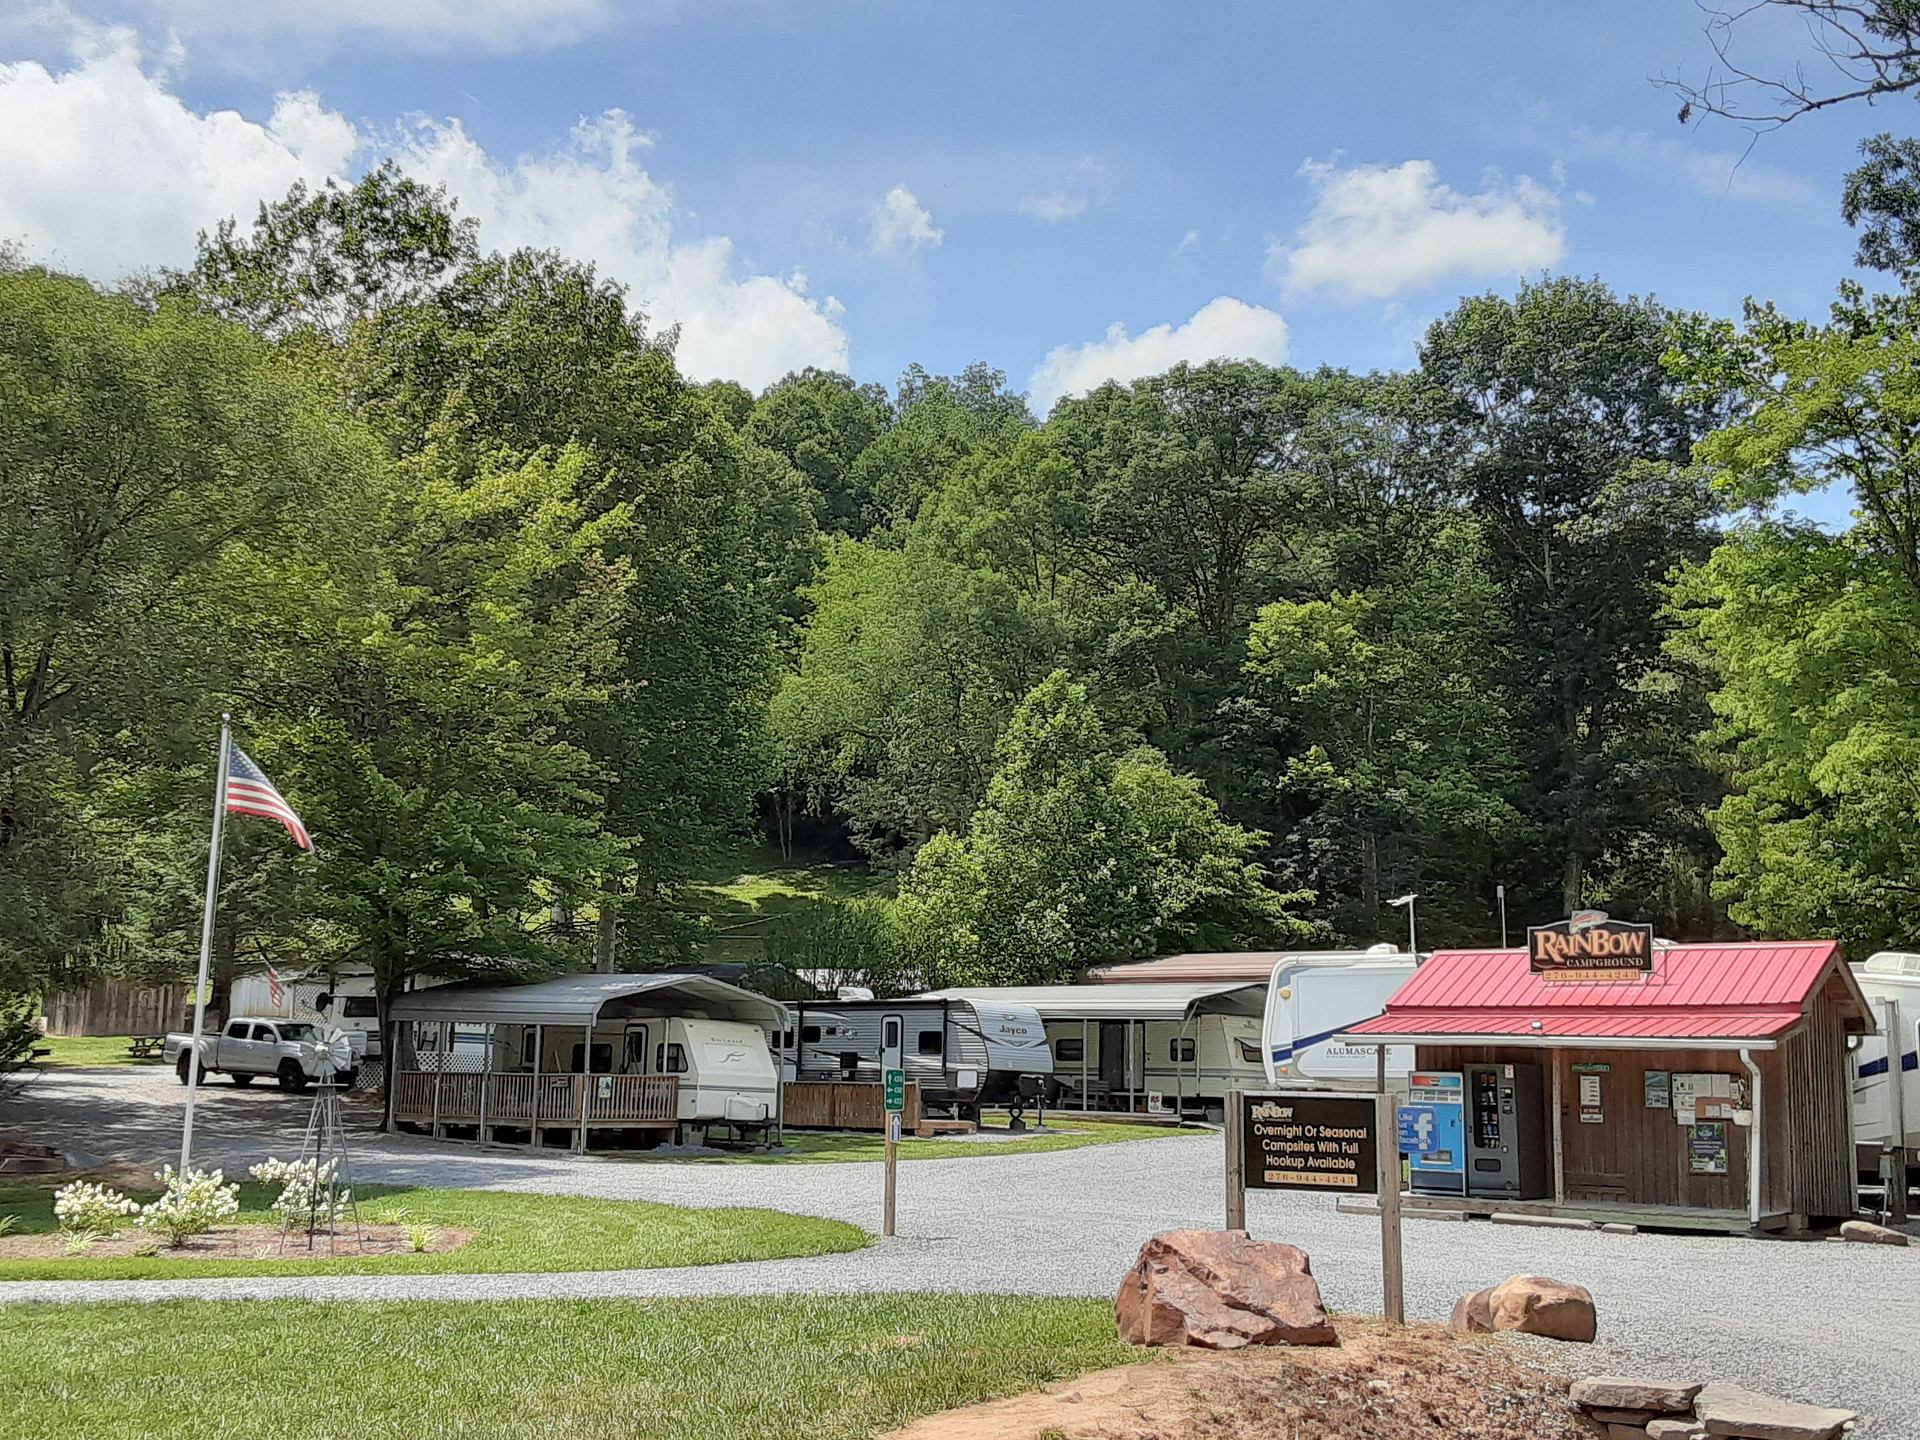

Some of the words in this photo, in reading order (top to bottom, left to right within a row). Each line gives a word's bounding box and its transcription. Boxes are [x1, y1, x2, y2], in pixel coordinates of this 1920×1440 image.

[1566, 957, 1644, 968] CAMPGROUND
[999, 1024, 1028, 1036] Jayco
[1326, 1047, 1393, 1056] ALUMASCAE
[1253, 1123, 1303, 1139] Overnight
[1304, 1125, 1318, 1136] Or
[1319, 1126, 1367, 1139] Seasonal
[1262, 1138, 1316, 1154] Campsites
[1316, 1140, 1340, 1153] With
[1341, 1142, 1359, 1154] Full
[1265, 1154, 1306, 1169] Hookup
[1306, 1156, 1356, 1170] Available
